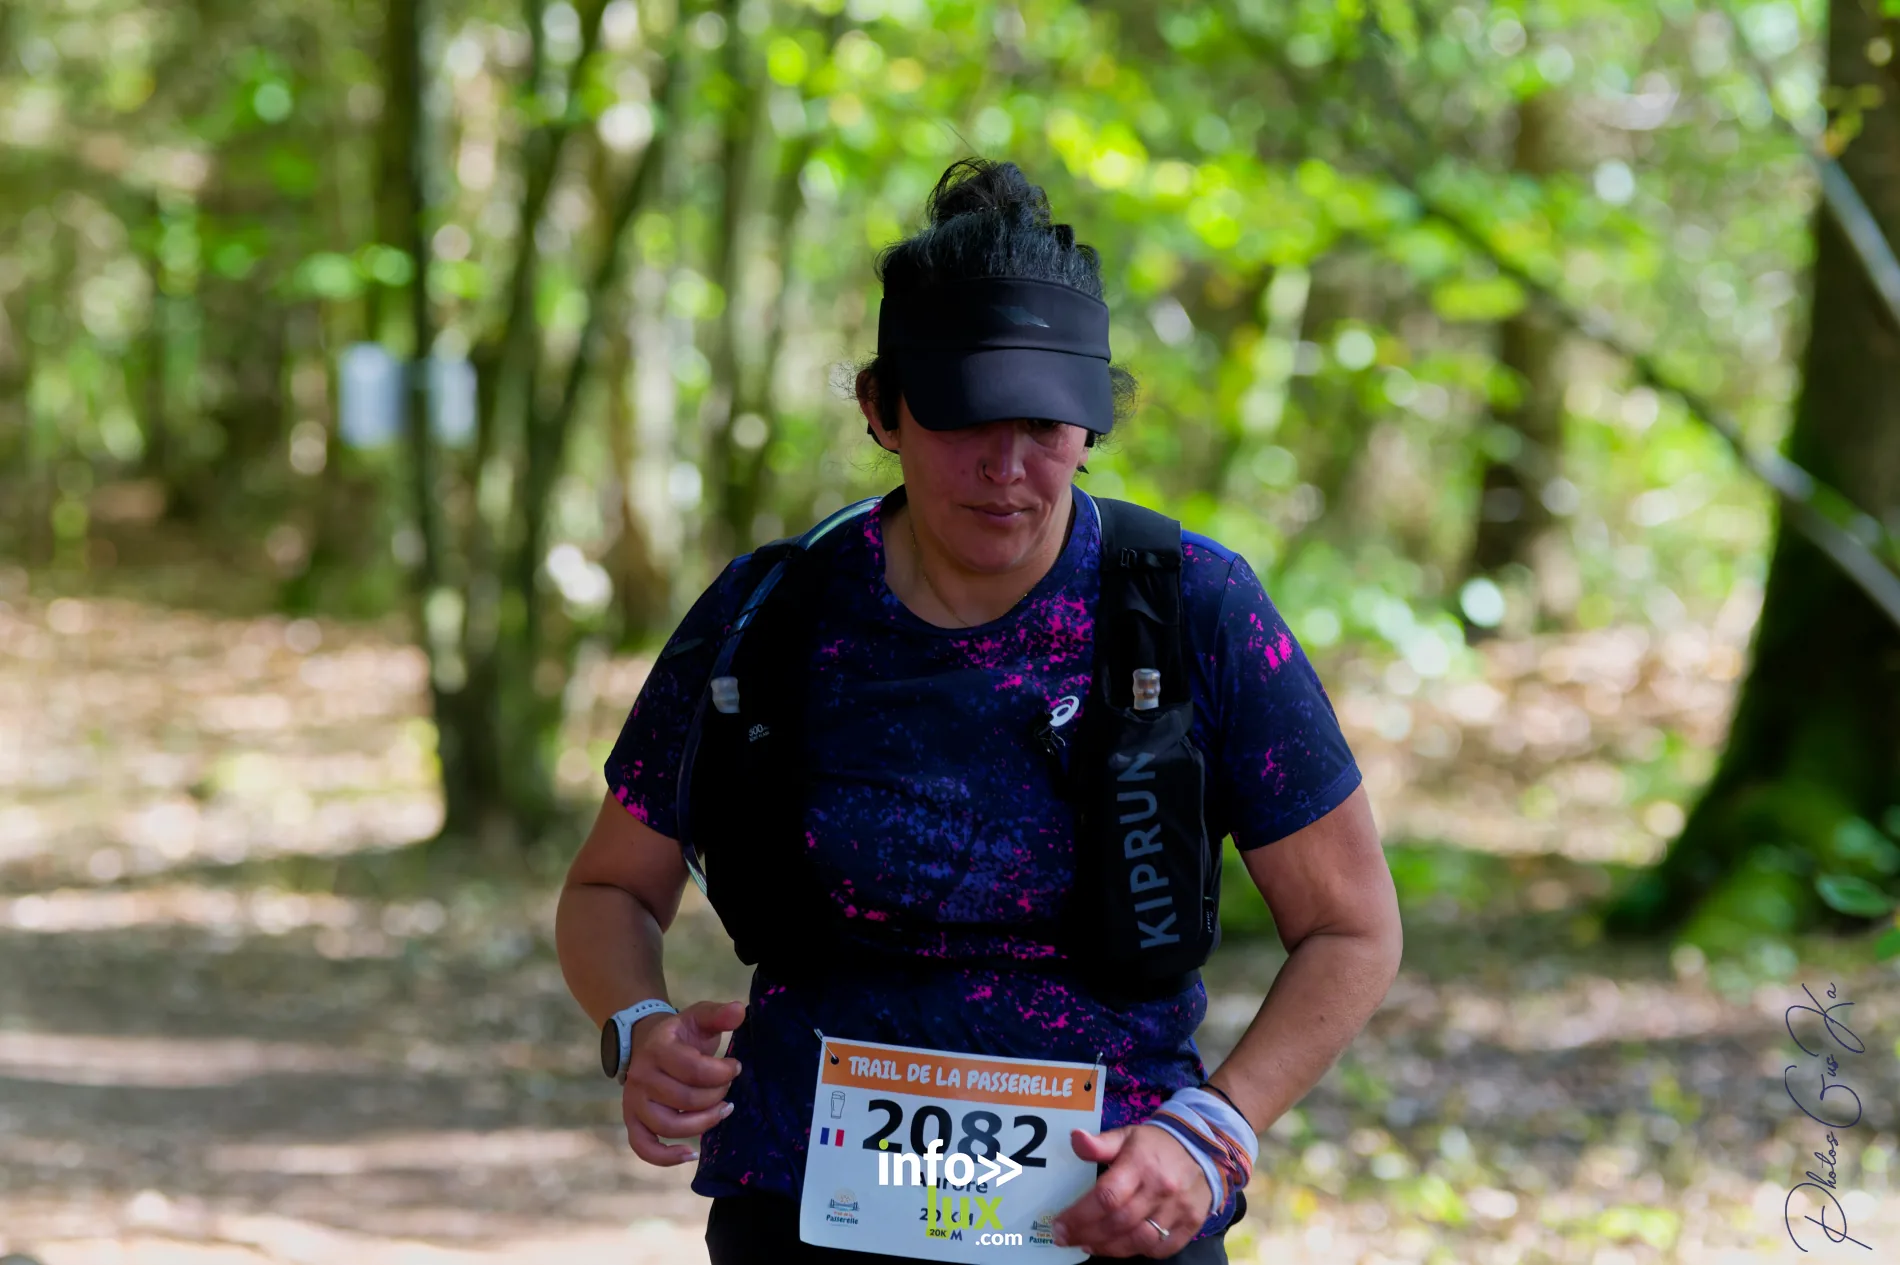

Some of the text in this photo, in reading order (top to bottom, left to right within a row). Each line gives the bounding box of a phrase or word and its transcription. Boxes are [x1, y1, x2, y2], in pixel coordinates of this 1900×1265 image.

[1116, 752, 1181, 949] KIPRUN
[848, 1056, 1074, 1098] TRAIL DE LA PASSERELLE
[862, 1099, 1048, 1168] 2082
[826, 1214, 858, 1224] Passerelle
[929, 1228, 947, 1238] 20K
